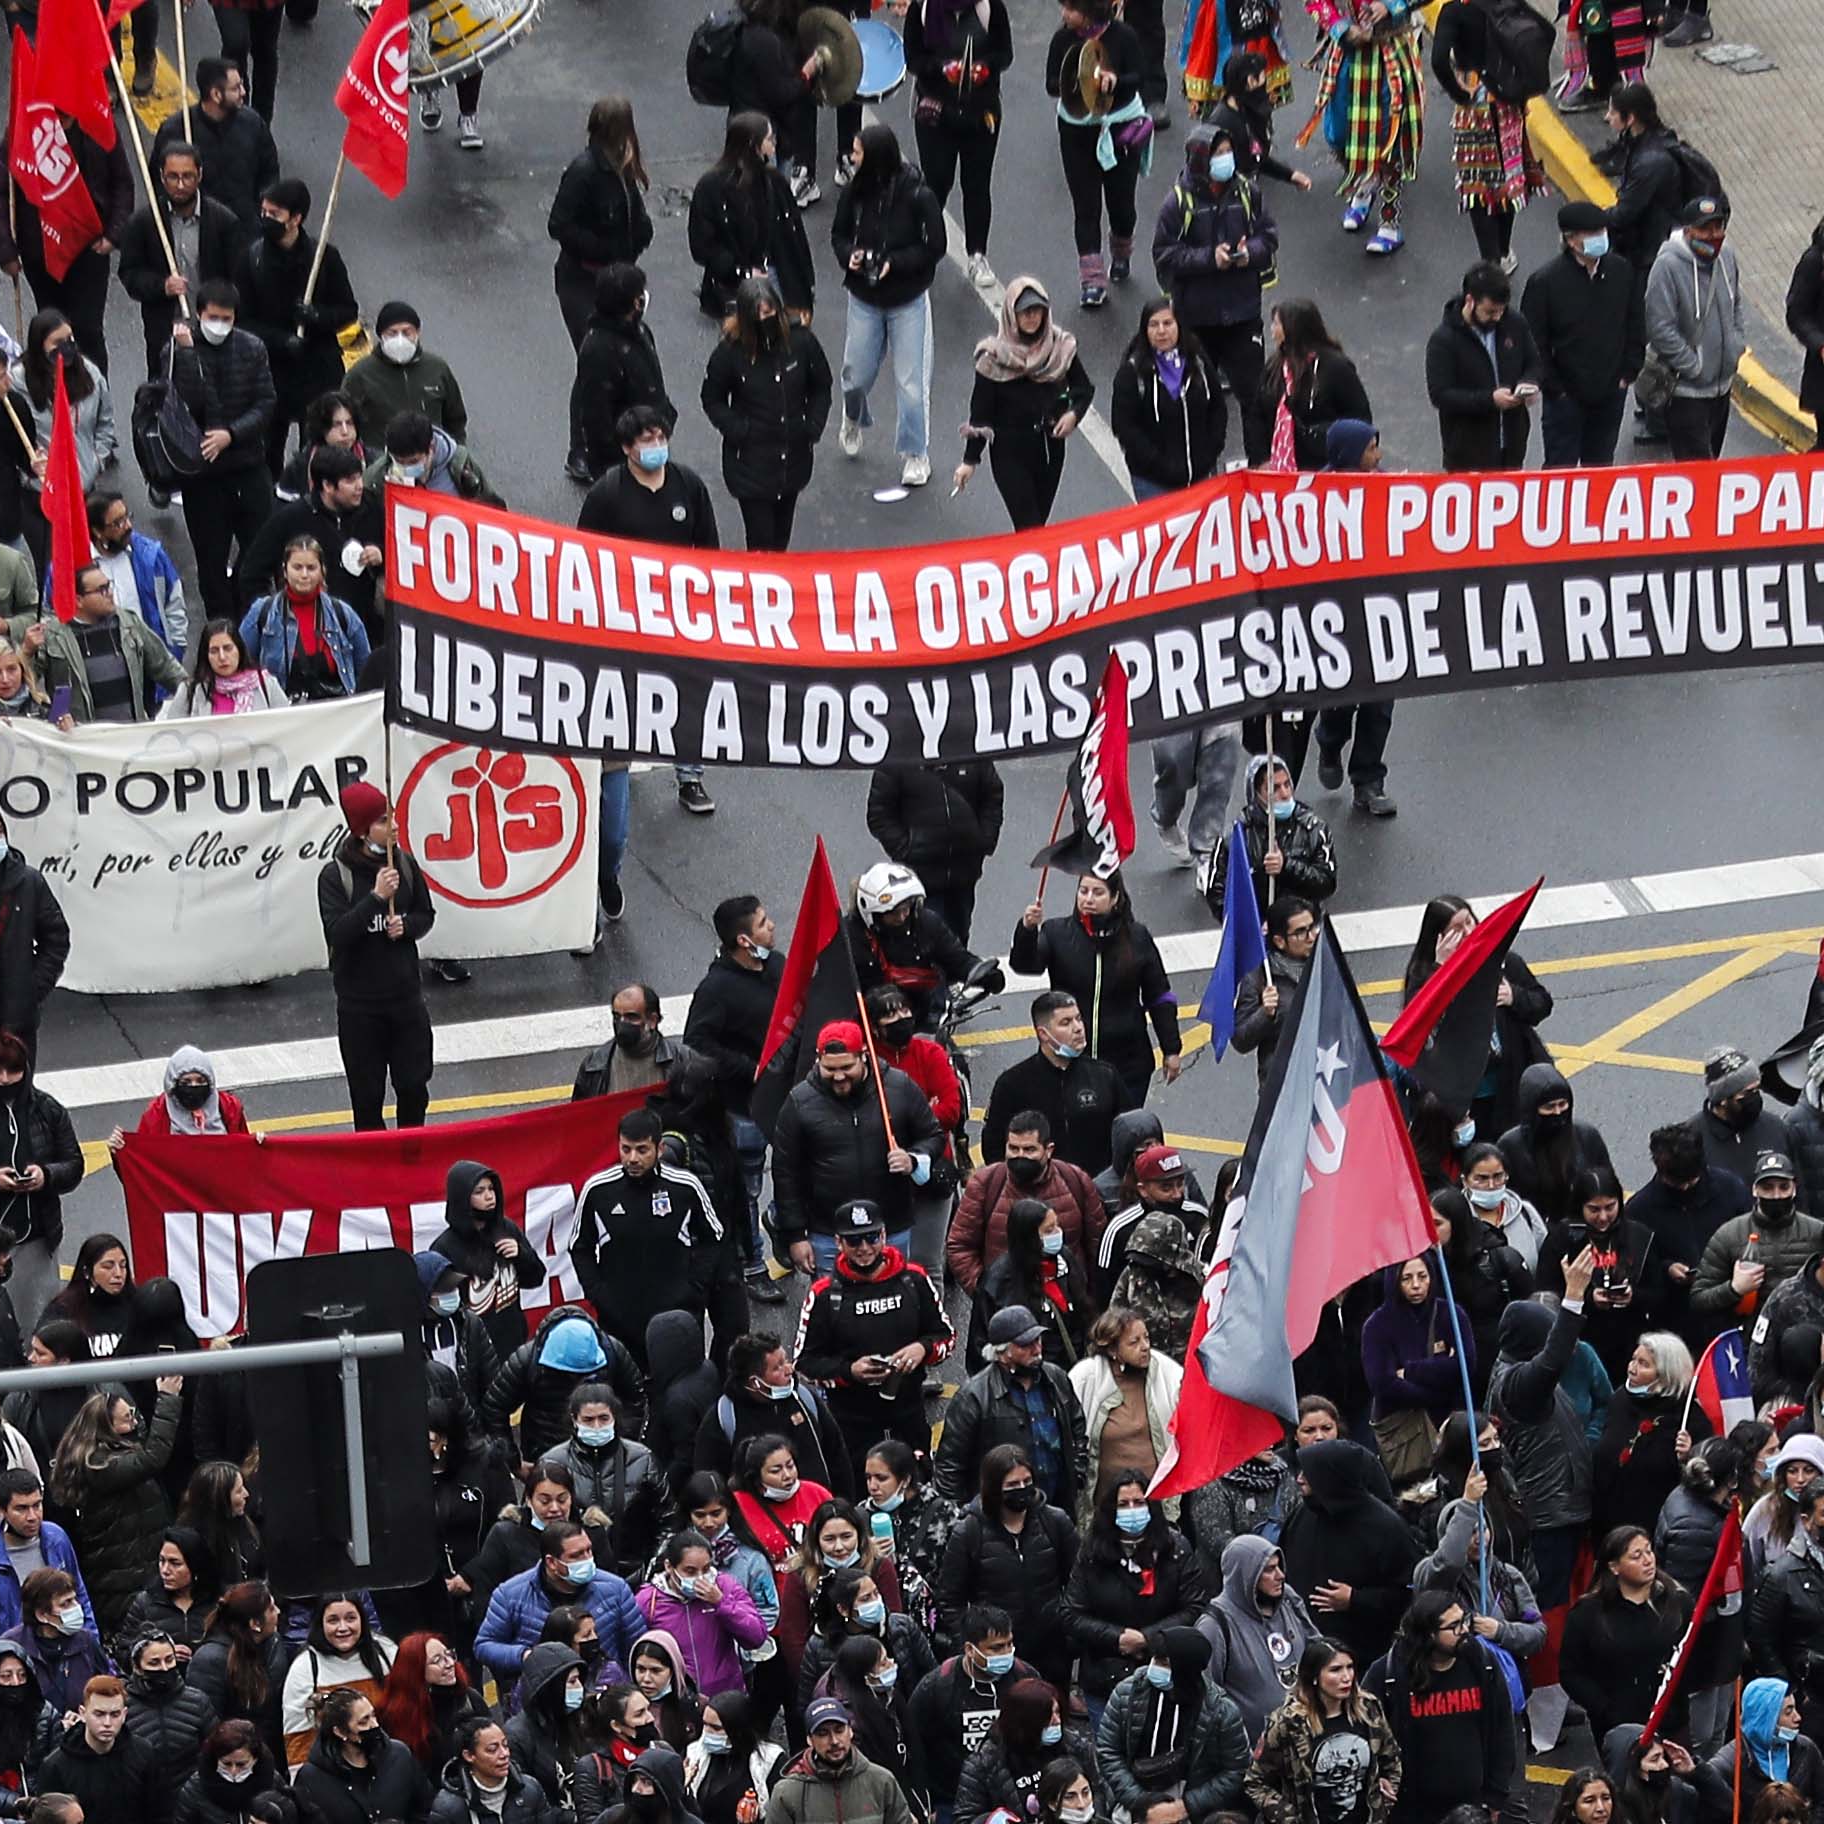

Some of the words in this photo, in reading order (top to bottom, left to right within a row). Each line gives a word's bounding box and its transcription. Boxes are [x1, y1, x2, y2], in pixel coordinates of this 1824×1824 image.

[396, 504, 798, 651] FORTALECER
[815, 572, 896, 652] LA
[917, 474, 1363, 649] ORGANIZACIÓN
[1387, 473, 1695, 555] POPULAR
[398, 623, 677, 754] LIBERAR
[701, 679, 745, 764] A
[767, 684, 889, 772] LOS
[905, 678, 949, 770] Y
[966, 652, 1091, 757] LAS
[1124, 601, 1349, 718] PRESAS
[1362, 588, 1450, 683] DE
[1465, 582, 1543, 668] LA
[78, 755, 368, 815] POPULAR
[92, 854, 155, 889] por
[168, 833, 241, 872] ellas
[254, 842, 285, 880] y
[856, 1296, 902, 1315] STREET
